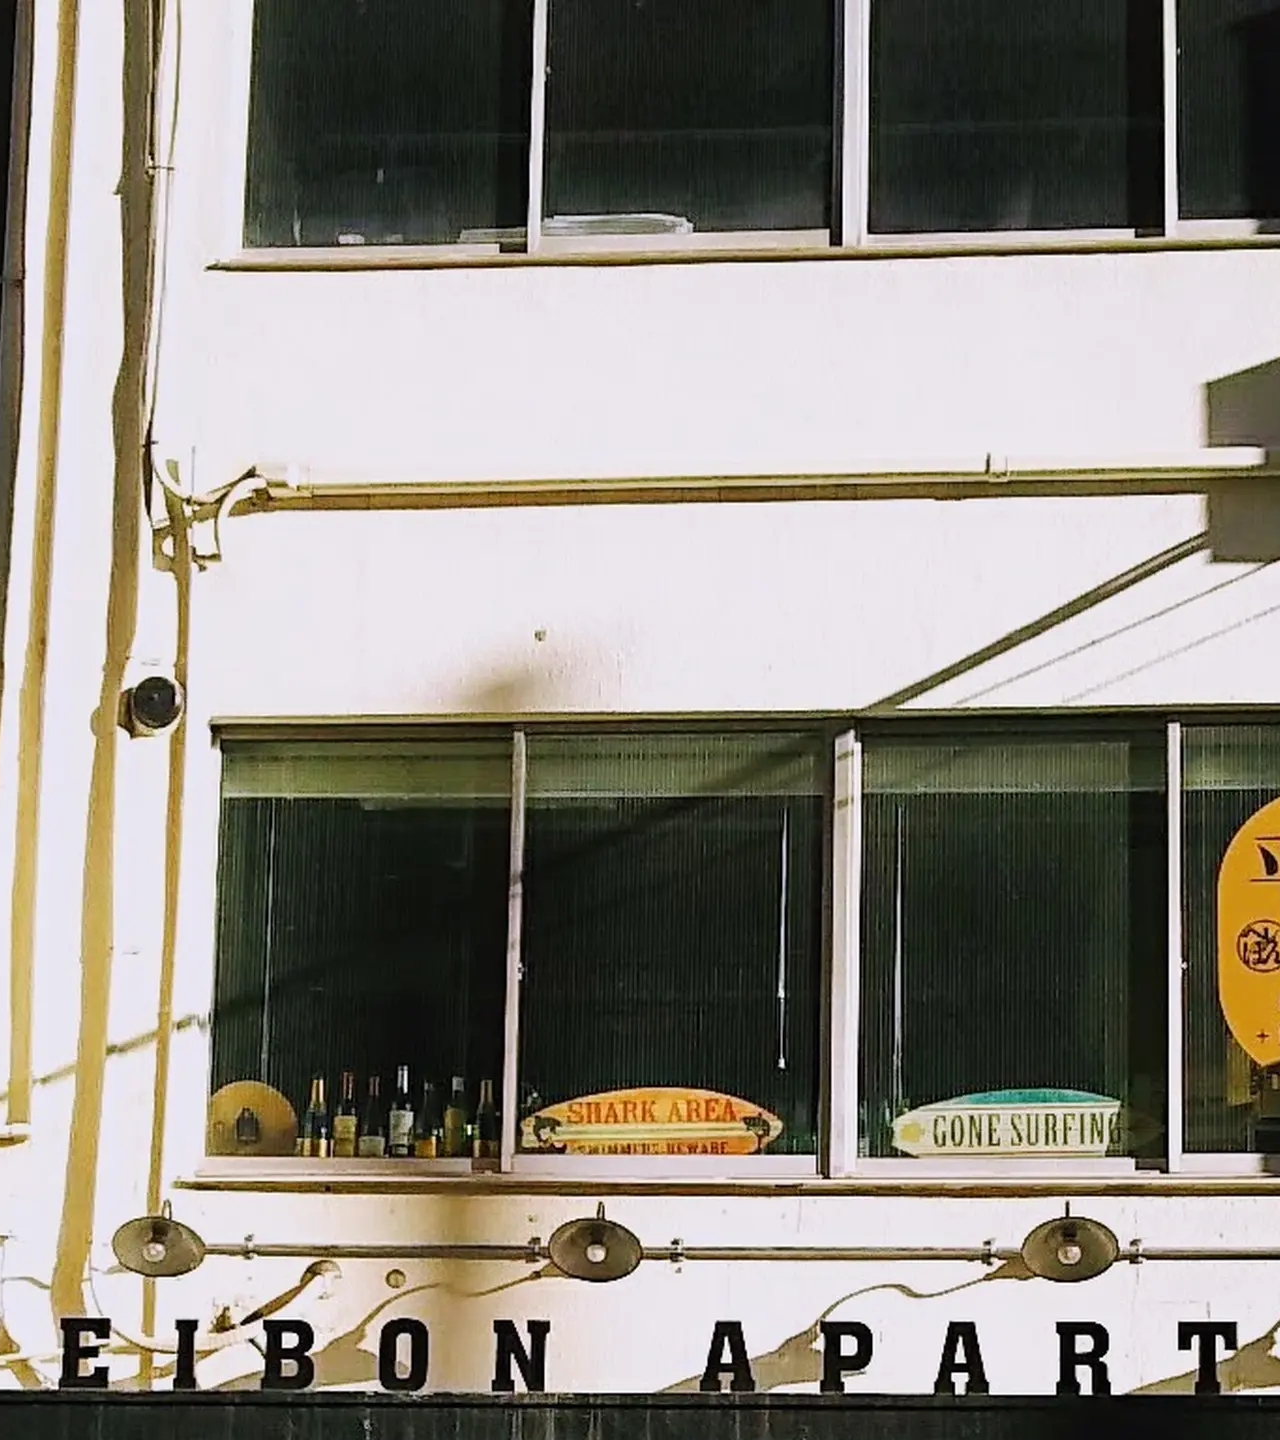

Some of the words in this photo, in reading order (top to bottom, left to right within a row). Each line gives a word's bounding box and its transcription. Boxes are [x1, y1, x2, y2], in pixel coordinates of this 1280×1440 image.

[567, 1100, 657, 1125] SHARK
[668, 1098, 738, 1123] AREA
[933, 1114, 1002, 1148] GONE
